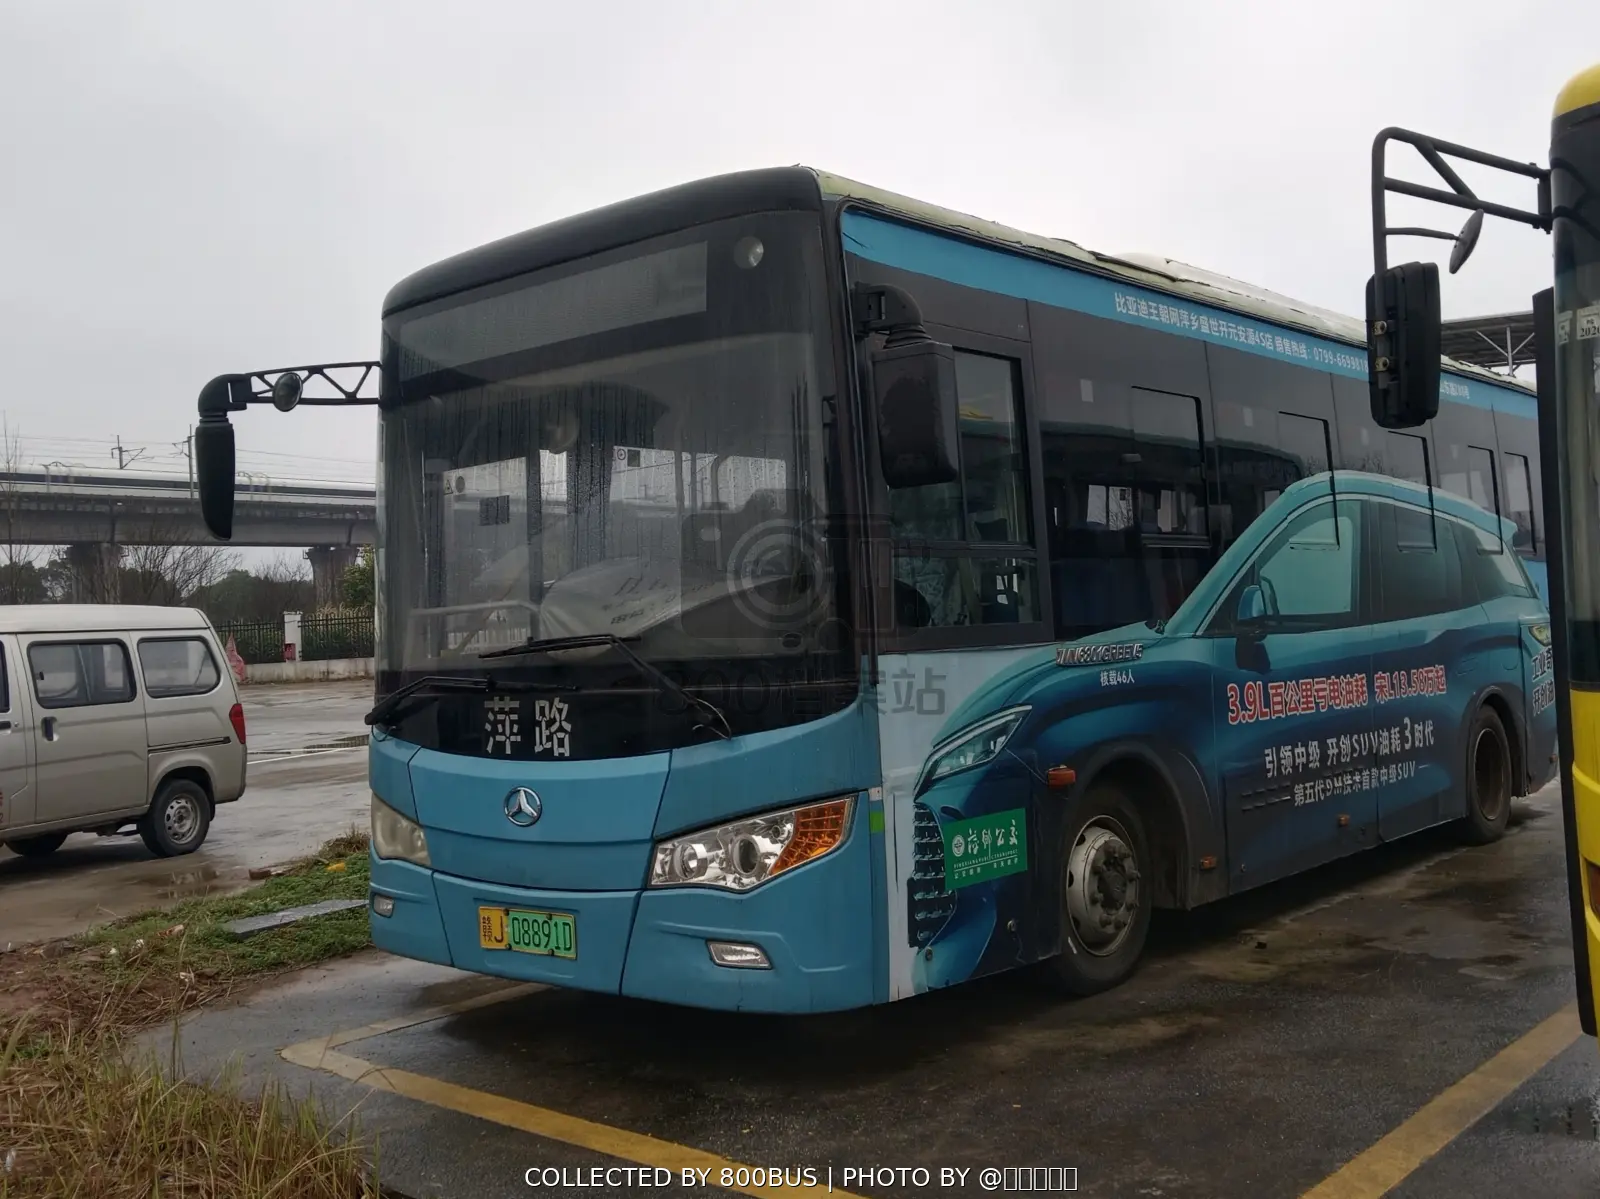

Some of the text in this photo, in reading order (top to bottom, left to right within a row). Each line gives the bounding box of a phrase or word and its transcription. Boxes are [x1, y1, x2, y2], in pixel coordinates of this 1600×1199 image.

[1100, 669, 1135, 687] 核载46人
[1227, 664, 1448, 725] 3.9L百公里亏电油耗 宋L13.58万起
[1264, 740, 1321, 779] 引领中级
